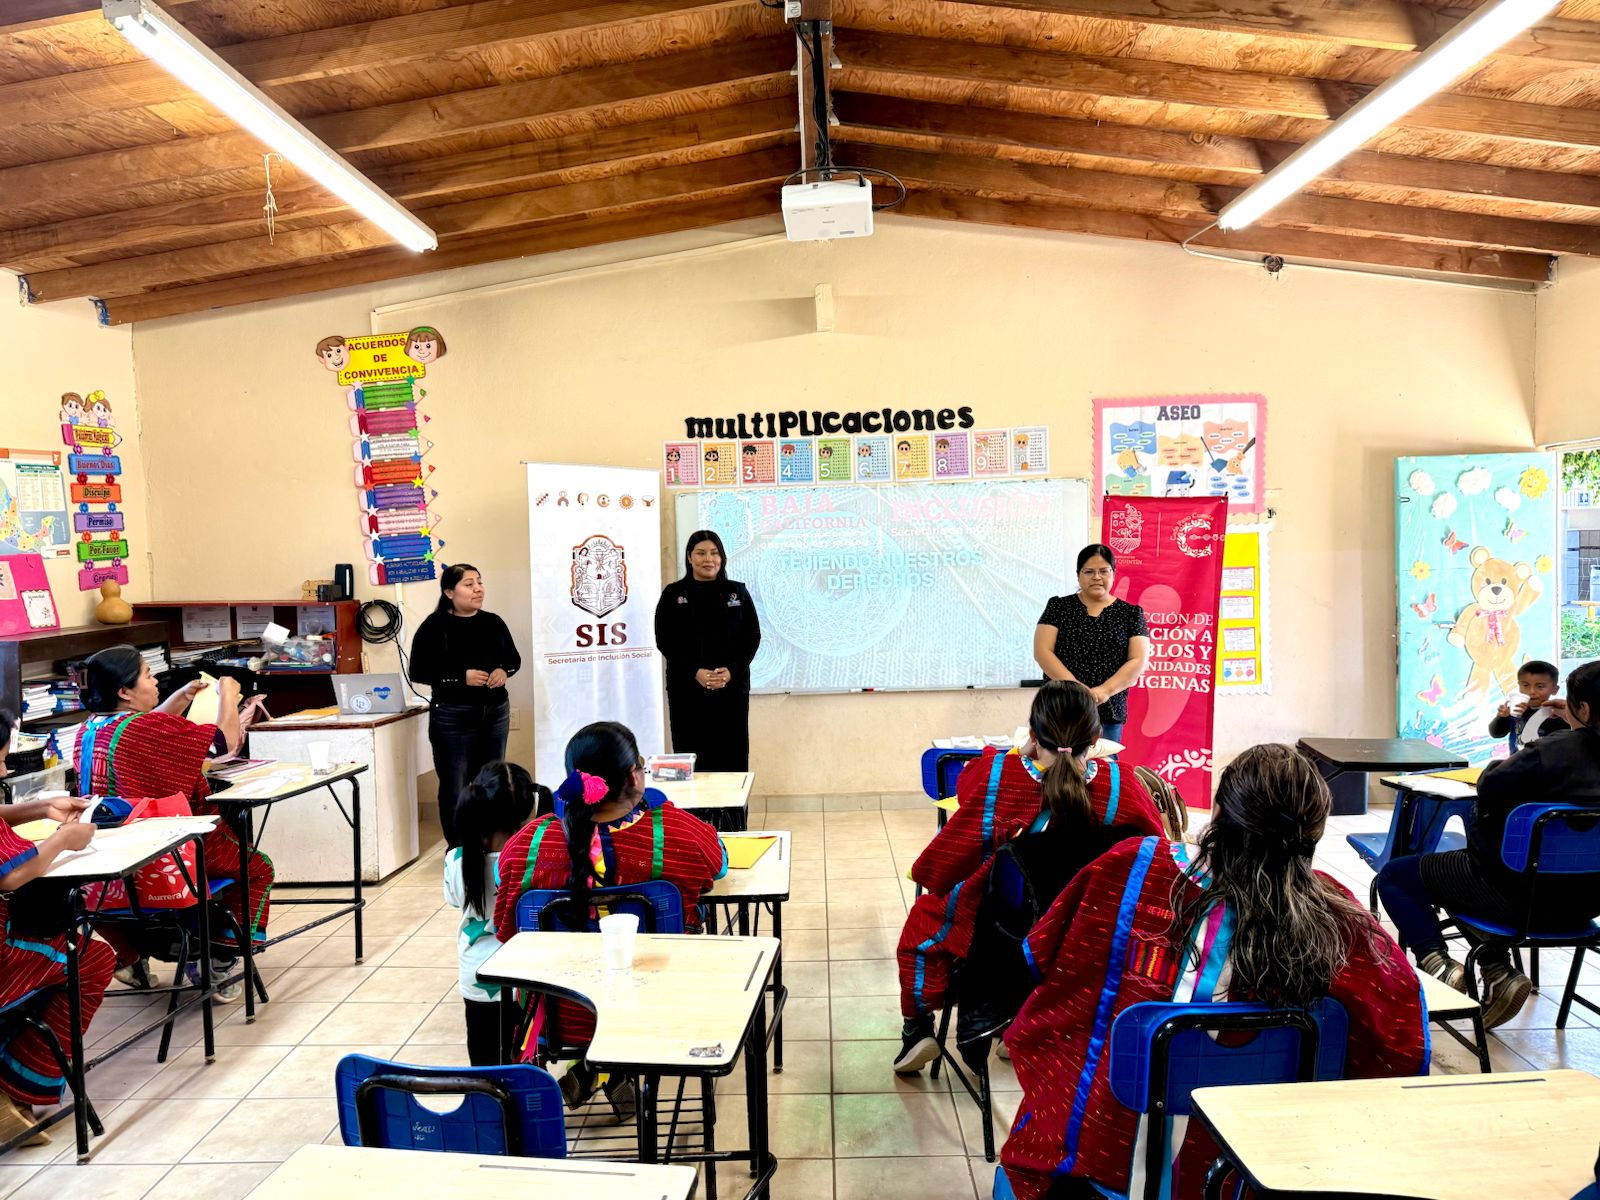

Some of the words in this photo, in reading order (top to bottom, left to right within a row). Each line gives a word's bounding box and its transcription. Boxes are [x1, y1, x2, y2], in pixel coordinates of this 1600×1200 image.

[348, 338, 406, 352] ACUERDOS
[373, 354, 387, 363] DE
[344, 365, 419, 379] CONVIVENCIA
[1157, 405, 1201, 421] ASEO
[77, 460, 100, 470] Buenos
[820, 463, 831, 477] 5
[859, 462, 870, 477] 6
[899, 460, 909, 474] 7
[937, 458, 948, 473] 8
[976, 456, 987, 471] 9
[668, 468, 675, 482] 1
[705, 467, 716, 481] 2
[744, 466, 754, 480] 3
[782, 464, 793, 478] 4
[760, 493, 835, 515] BAJA
[780, 554, 873, 571] TEJIENDO
[879, 550, 984, 568] NUESTROS
[827, 572, 936, 590] DERECHOS
[1194, 613, 1213, 626] DE
[576, 622, 627, 648] SIS
[1200, 629, 1213, 643] A
[1199, 645, 1213, 660] Y
[148, 892, 182, 901] Aurrera
